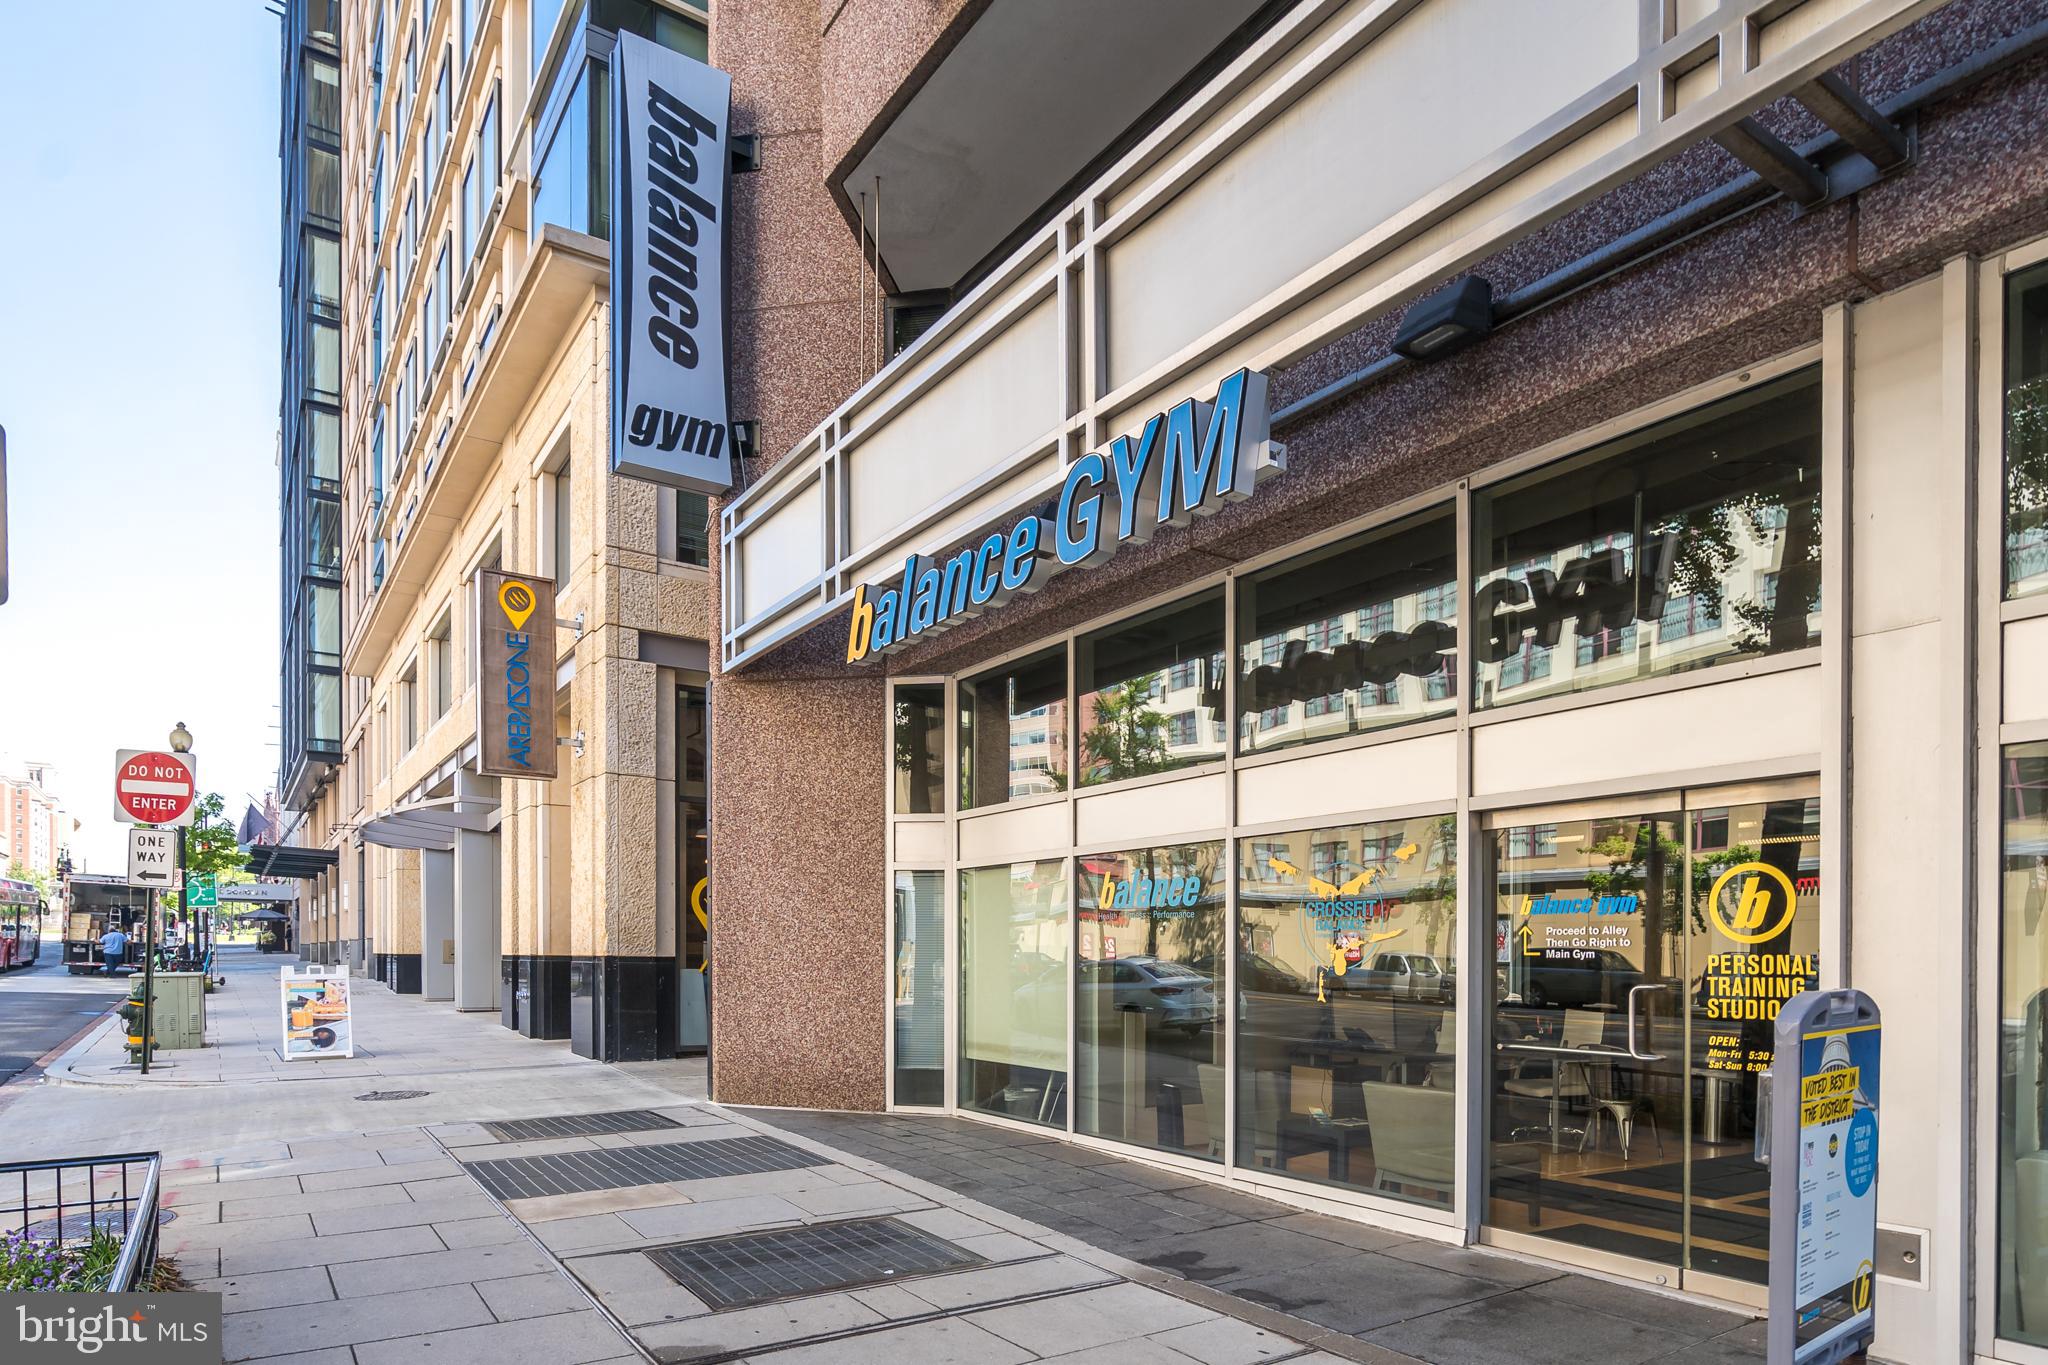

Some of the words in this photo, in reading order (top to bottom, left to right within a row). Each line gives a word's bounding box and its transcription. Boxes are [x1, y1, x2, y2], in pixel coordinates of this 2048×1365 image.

[647, 79, 717, 370] balance
[628, 402, 725, 459] gym
[846, 514, 1041, 665] balance
[1055, 366, 1251, 567] GYM
[128, 764, 148, 777] DO
[154, 766, 184, 779] NOT
[132, 796, 177, 811] ENTER
[137, 835, 166, 848] ONE
[136, 851, 166, 863] WAY
[1099, 868, 1201, 910] balance
[1305, 900, 1377, 918] CROSSFIT
[1520, 895, 1593, 915] balance
[1597, 895, 1639, 916] gym
[1098, 912, 1118, 920] Health
[1152, 910, 1195, 919] Performance
[1315, 919, 1364, 931] BALANCE
[1546, 926, 1586, 935] Proceed
[1589, 926, 1600, 935] to
[1602, 925, 1628, 937] Alley
[1546, 938, 1569, 947] Then
[1572, 938, 1587, 947] Go
[1589, 938, 1616, 949] Right
[1619, 938, 1631, 947] to
[1546, 949, 1570, 959] Main
[1572, 949, 1595, 961] Gym
[1707, 954, 1817, 976] PERSONAL
[1706, 976, 1805, 998] TRAINING
[1707, 998, 1781, 1020] STUDIO
[1708, 1036, 1740, 1047] OPEN:
[1708, 1049, 1742, 1059] Mon-Fri
[1748, 1051, 1769, 1060] 5:30
[1708, 1060, 1742, 1071] Sat-Sun
[1746, 1063, 1767, 1072] 8:00
[1805, 1077, 1827, 1098] VOTED
[1829, 1073, 1847, 1092] BEST
[1849, 1069, 1857, 1087] IN
[1804, 1104, 1819, 1123] THE
[1819, 1098, 1850, 1119] DISTRICT
